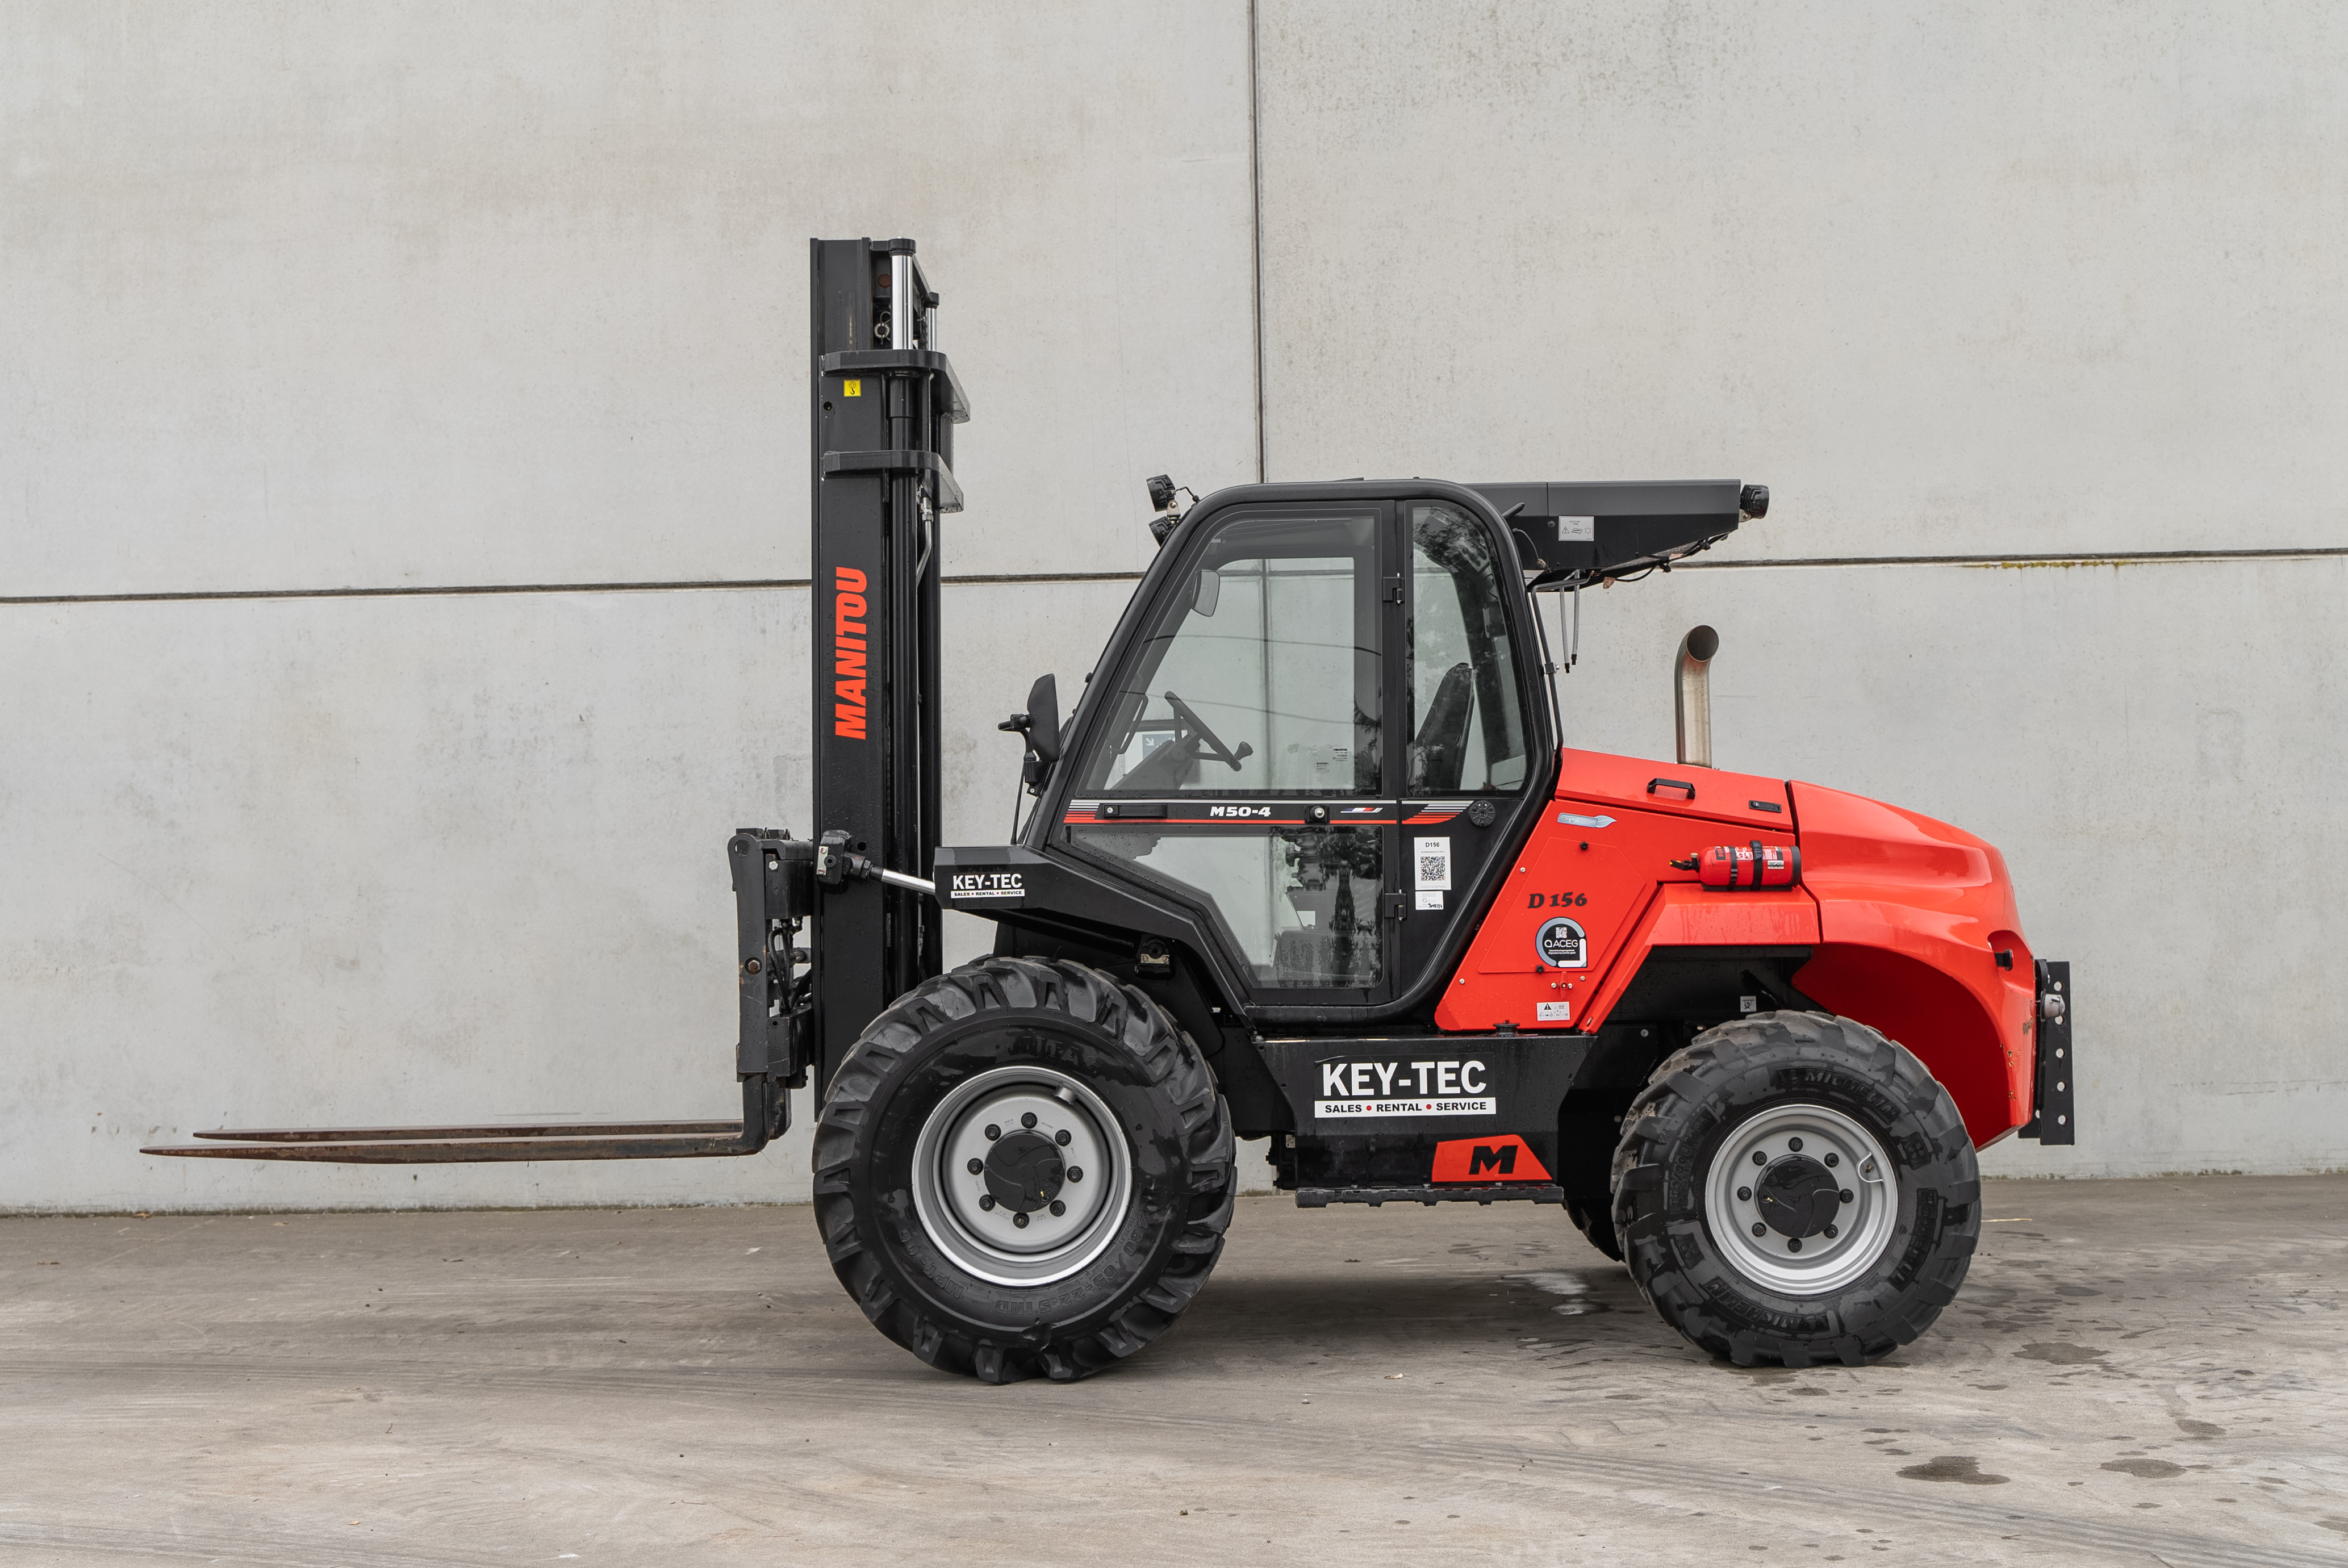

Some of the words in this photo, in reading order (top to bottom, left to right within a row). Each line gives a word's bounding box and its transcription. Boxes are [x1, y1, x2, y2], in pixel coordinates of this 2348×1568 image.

[835, 567, 867, 740] MANITOU
[1210, 806, 1271, 817] M50-4
[952, 873, 1022, 890] KEY-TEC
[1528, 893, 1545, 909] D
[1549, 892, 1587, 908] 156
[1553, 939, 1578, 948] ACEG
[1323, 1060, 1486, 1096] KEY-TEC
[1803, 1068, 1898, 1121] MICHELIN
[1325, 1104, 1362, 1113] SALES
[1376, 1103, 1422, 1112] RENTAL
[1436, 1102, 1487, 1111] SERVICE
[1469, 1145, 1518, 1175] M
[993, 1299, 1033, 1315] IND
[1704, 1276, 1800, 1330] MICHELIN
